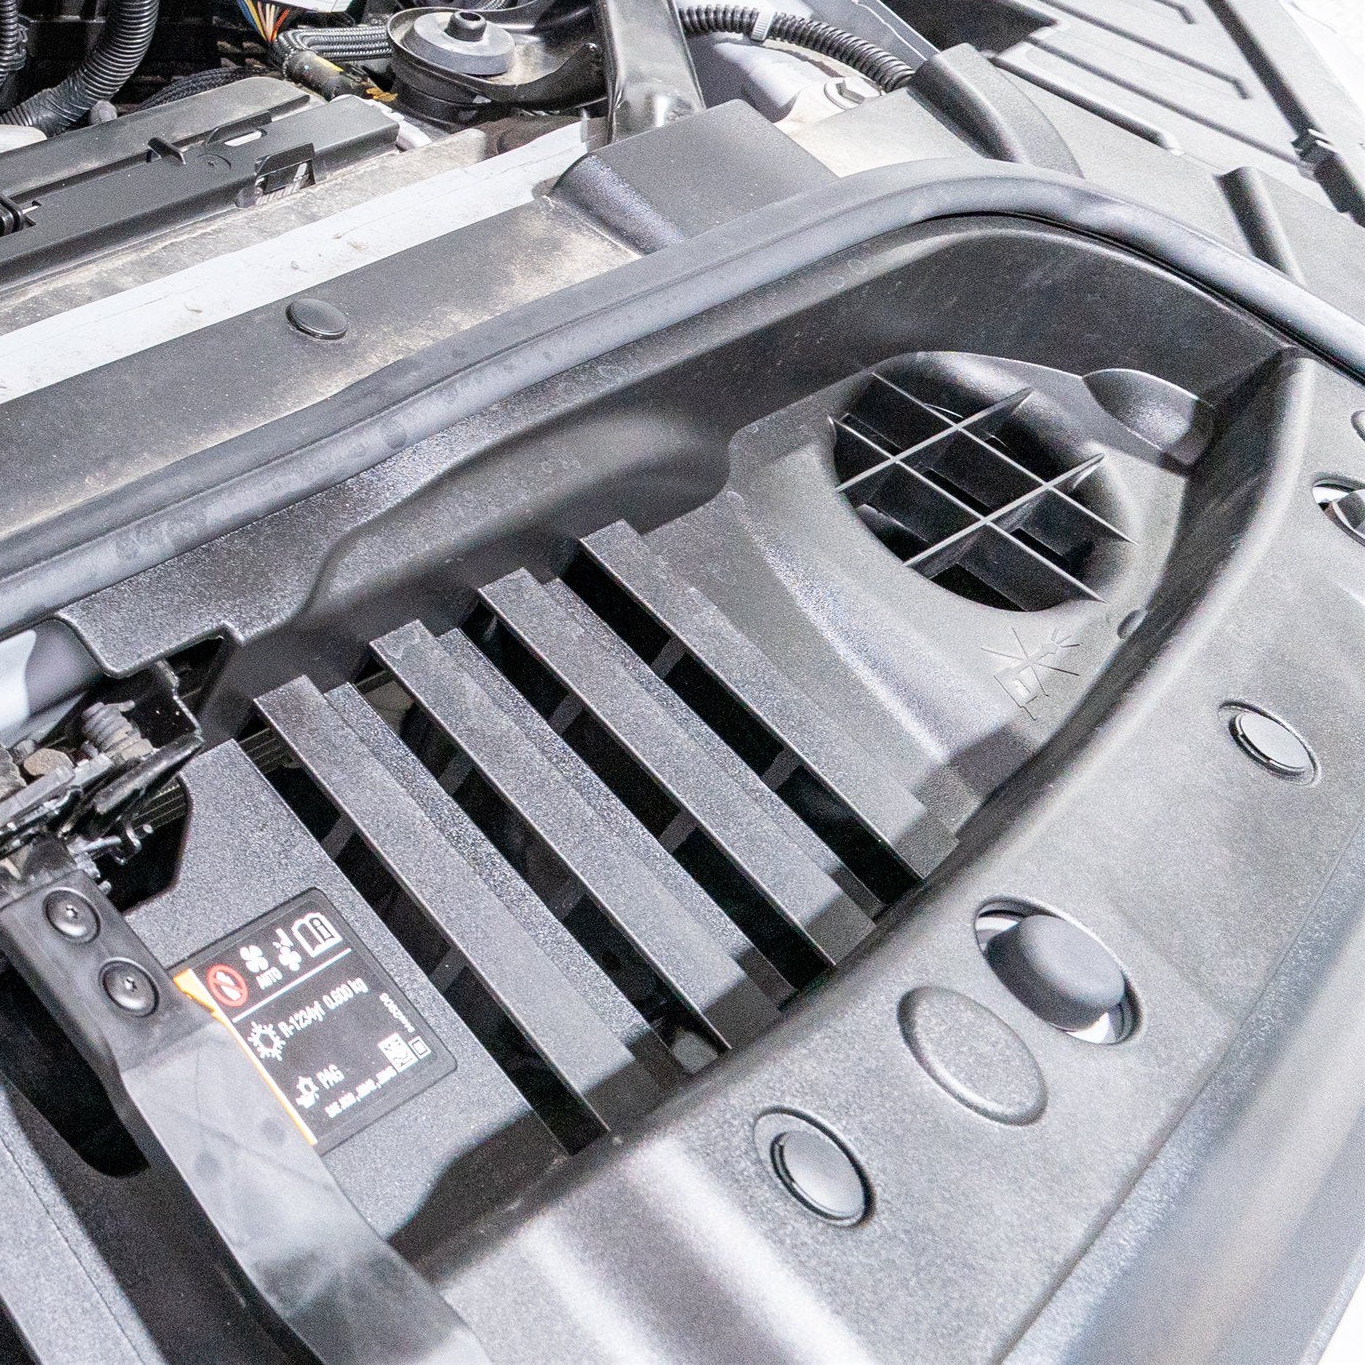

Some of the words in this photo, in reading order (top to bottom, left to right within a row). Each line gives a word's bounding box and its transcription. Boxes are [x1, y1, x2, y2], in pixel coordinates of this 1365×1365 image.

[256, 966, 283, 990] AUTO
[277, 1000, 326, 1038] R-1234yf
[347, 977, 369, 994] kg
[316, 1064, 345, 1090] PAG
